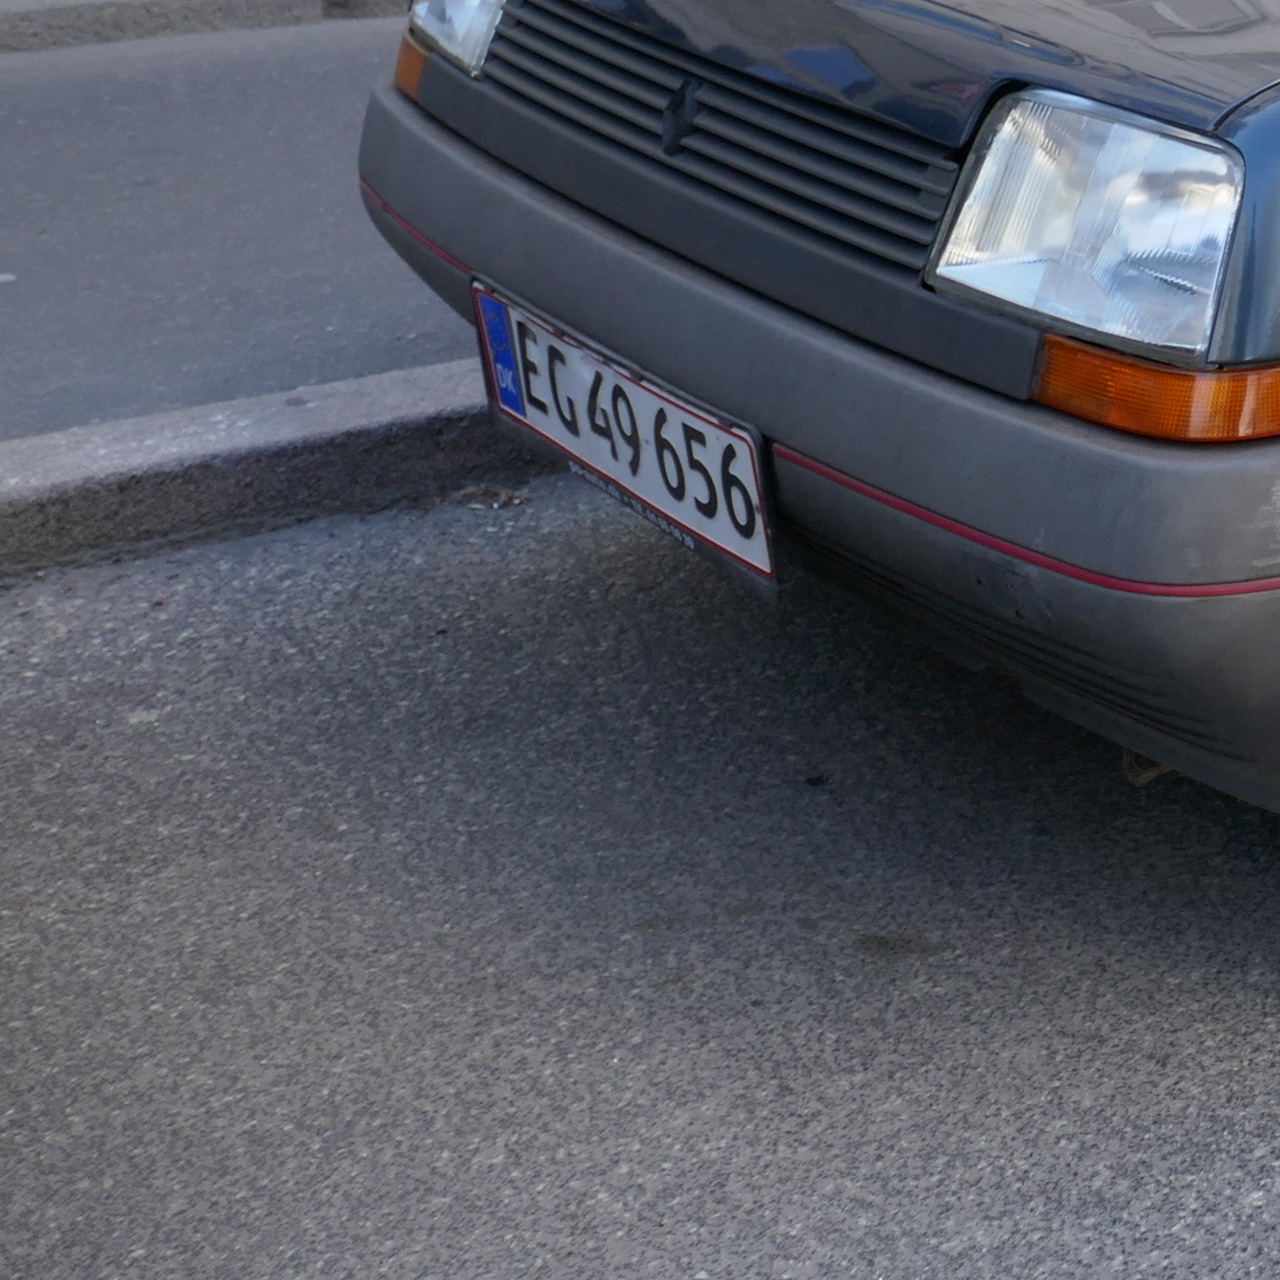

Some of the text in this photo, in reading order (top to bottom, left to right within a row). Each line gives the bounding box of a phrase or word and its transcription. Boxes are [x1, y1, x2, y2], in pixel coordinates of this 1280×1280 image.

[496, 363, 516, 395] DK
[587, 369, 641, 477] 49
[653, 407, 756, 540] 656
